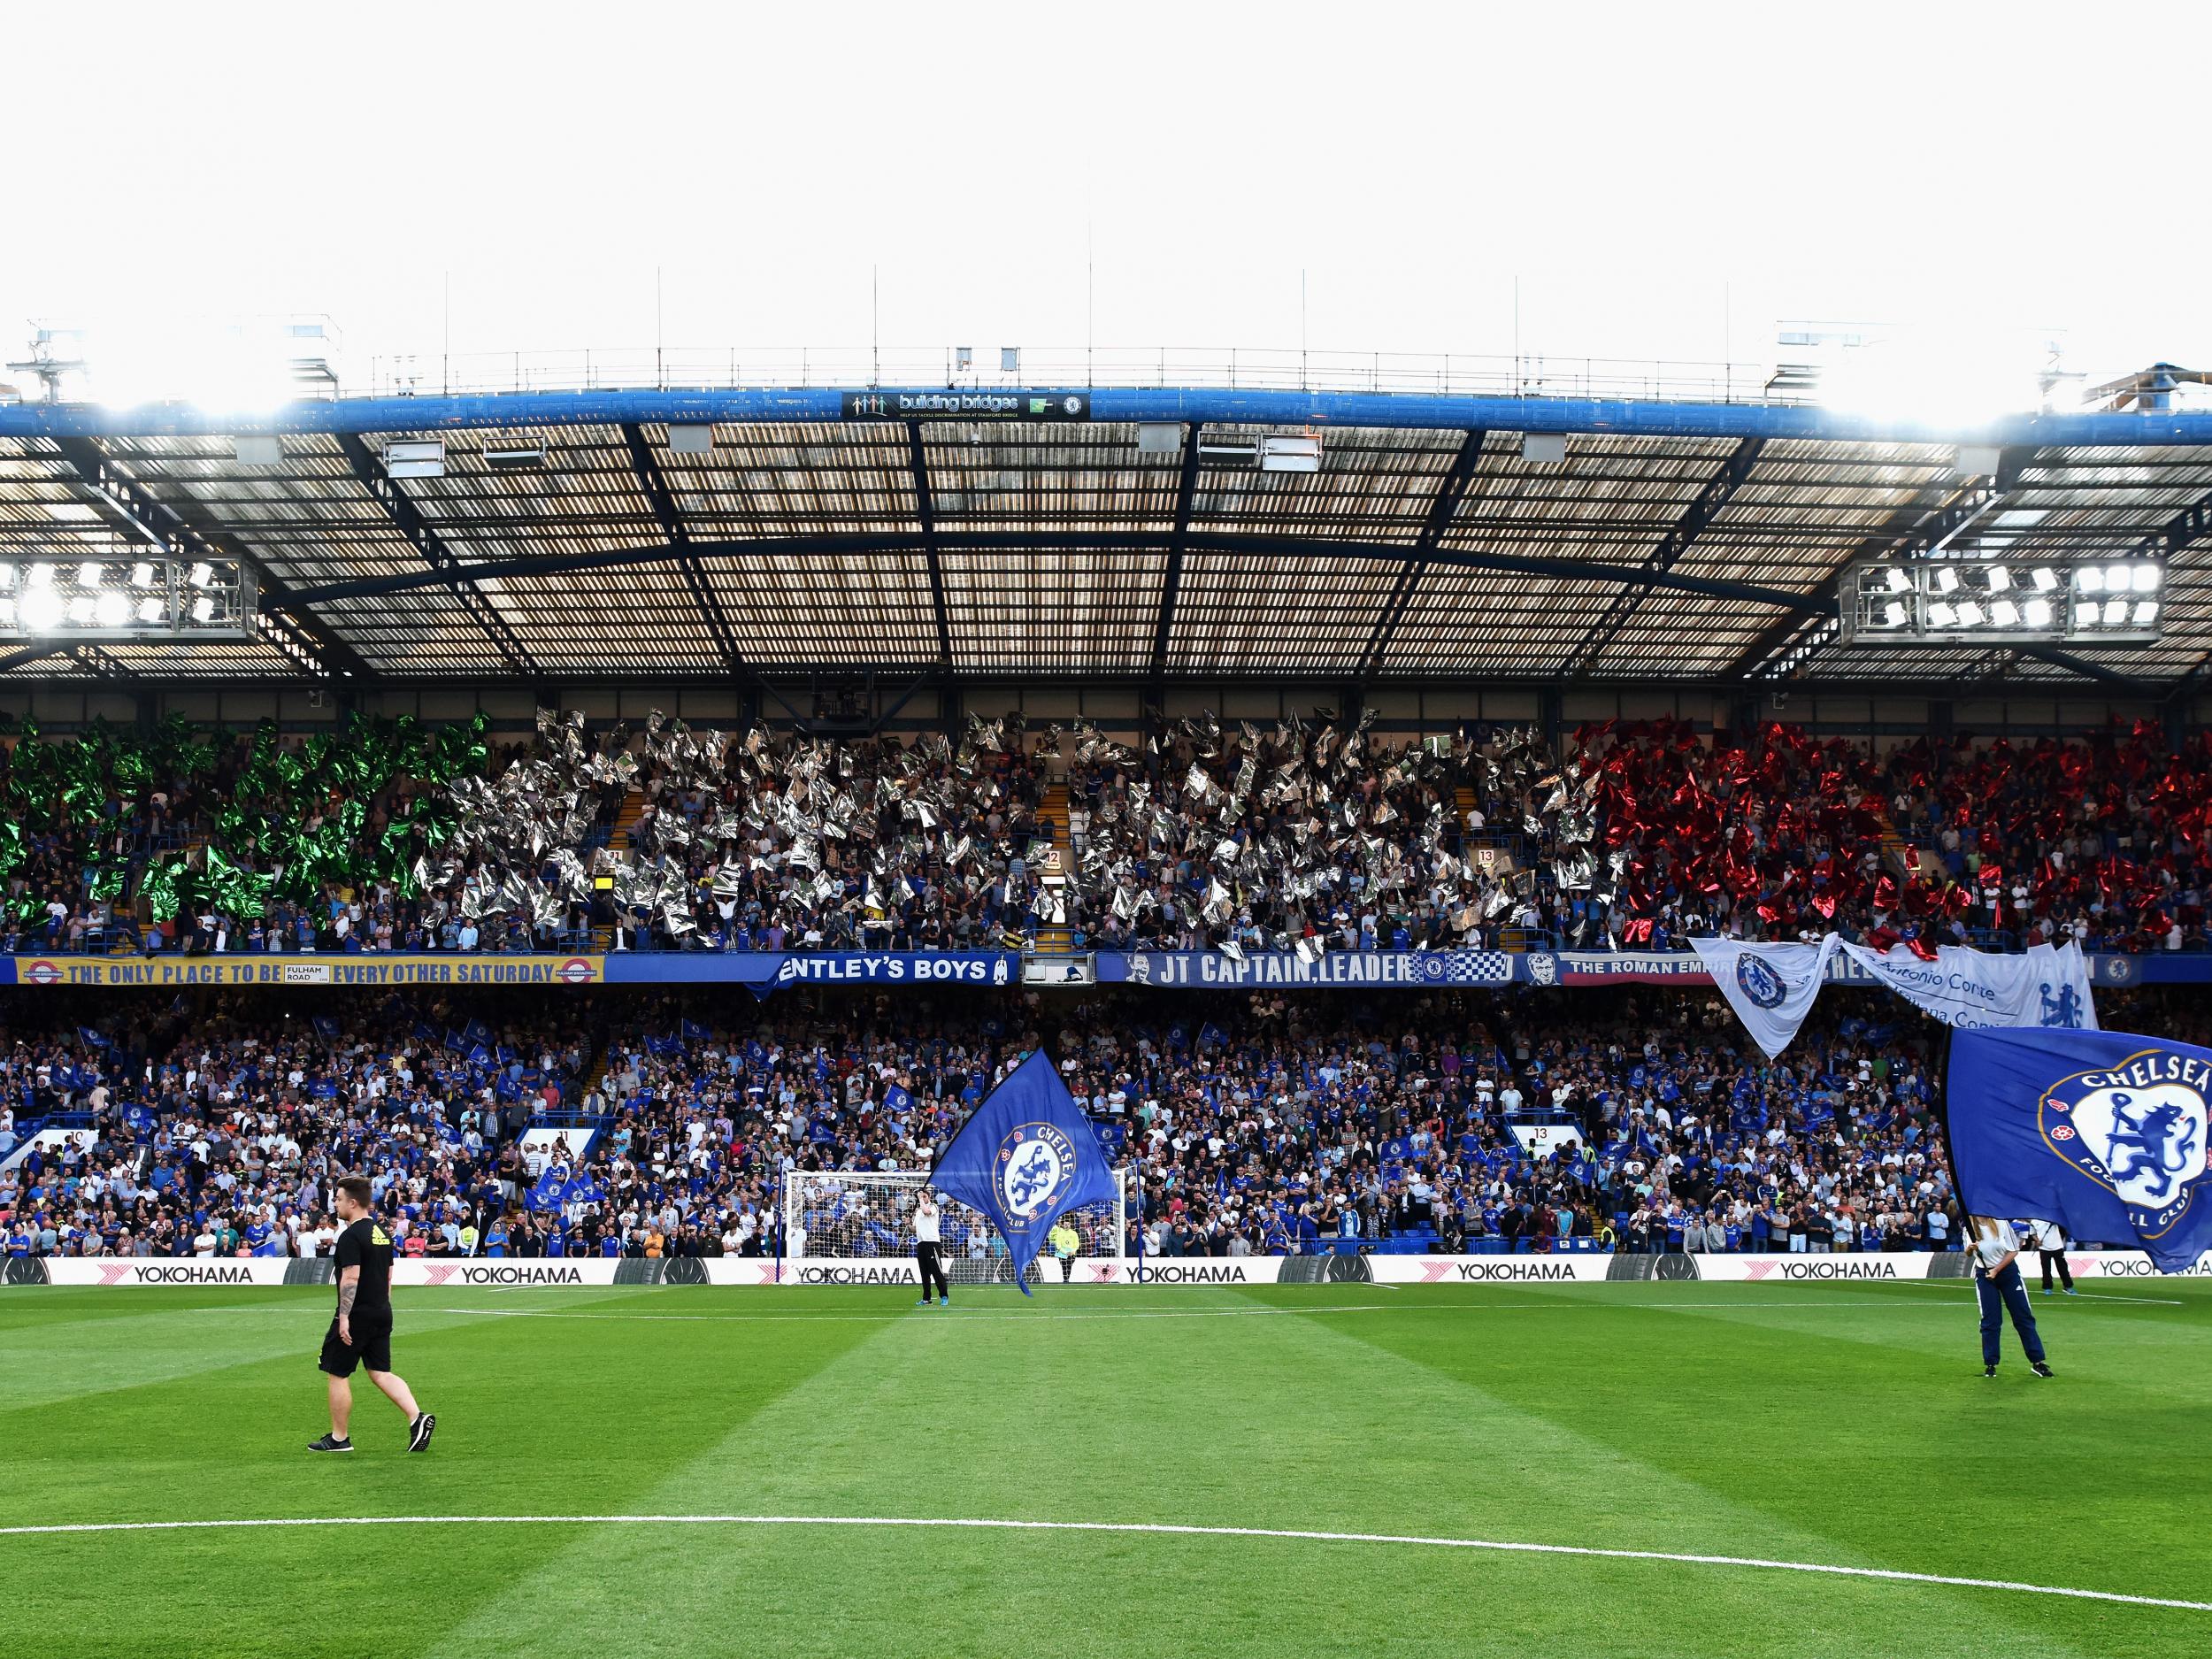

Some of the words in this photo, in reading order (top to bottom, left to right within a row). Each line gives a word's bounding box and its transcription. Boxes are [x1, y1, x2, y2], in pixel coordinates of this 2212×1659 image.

[899, 395, 960, 412] building
[962, 395, 1018, 412] bridges
[1480, 851, 1493, 861] 13
[68, 965, 103, 984] THE
[109, 965, 155, 984] ONLY
[163, 964, 223, 984] PLACE
[231, 964, 254, 983] TO
[259, 964, 280, 982] BE
[333, 964, 389, 983] EVERY
[392, 963, 451, 983] OTHER
[457, 964, 555, 983] SATURDAY
[779, 956, 904, 981] ENTLEY'S
[914, 959, 987, 979] BOYS
[1160, 956, 1189, 983] JT
[1570, 961, 1605, 974] THE
[1611, 961, 1672, 974] ROMAN
[2081, 1056, 2211, 1092] CHELSEA
[1534, 1127, 1548, 1139] 13
[1037, 1126, 1074, 1182] CHELSEA
[2159, 1187, 2189, 1226] CLUB
[134, 1266, 253, 1283] YOKOHAMA
[461, 1267, 582, 1283] YOKOHAMA
[797, 1267, 916, 1284] YOKOHAMA
[1125, 1265, 1247, 1283] YOKOHAMA
[1457, 1263, 1576, 1280] YOKOHAMA
[1780, 1262, 1896, 1279] YOKOHAMA
[2100, 1260, 2212, 1276] YOKOMA
